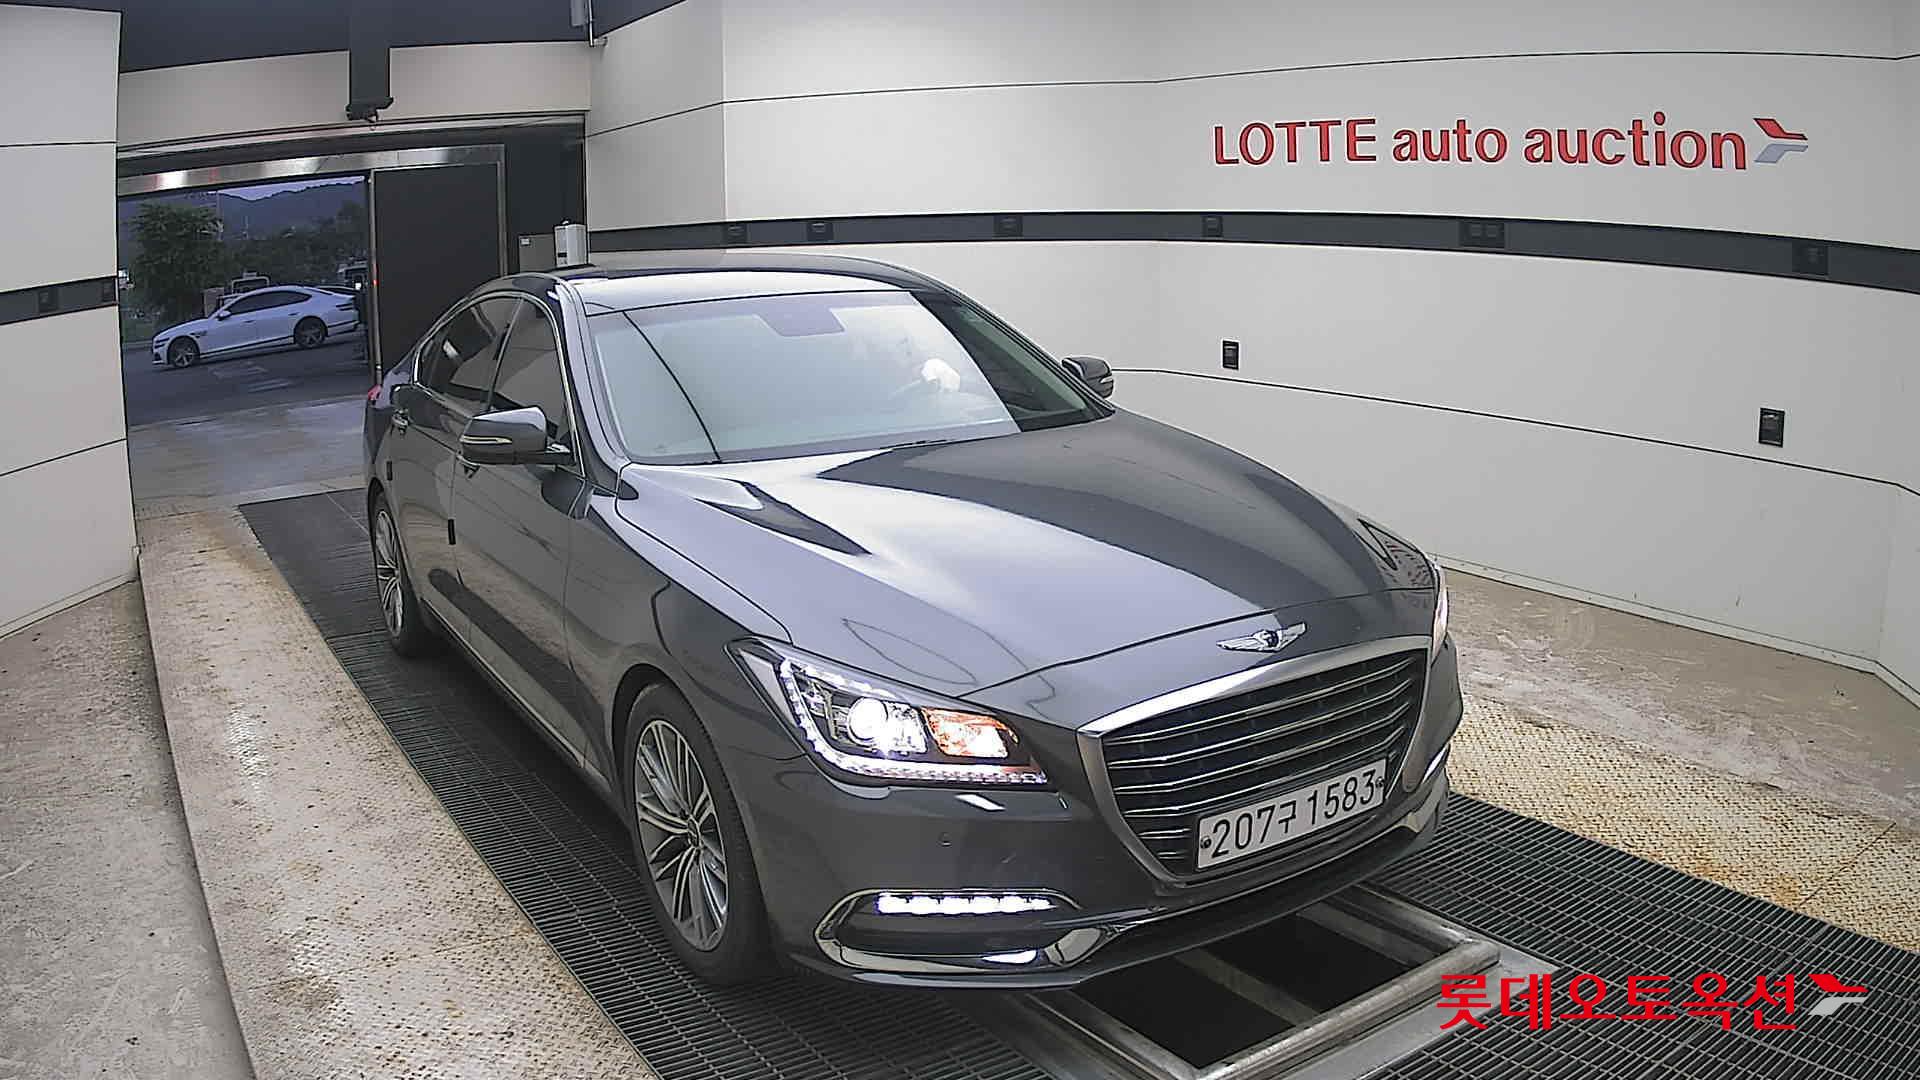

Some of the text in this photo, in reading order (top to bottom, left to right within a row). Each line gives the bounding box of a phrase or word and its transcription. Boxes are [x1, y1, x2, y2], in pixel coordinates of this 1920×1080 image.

[1213, 111, 1748, 170] LOTTE auto auction
[1211, 769, 1376, 859] 207구 1583
